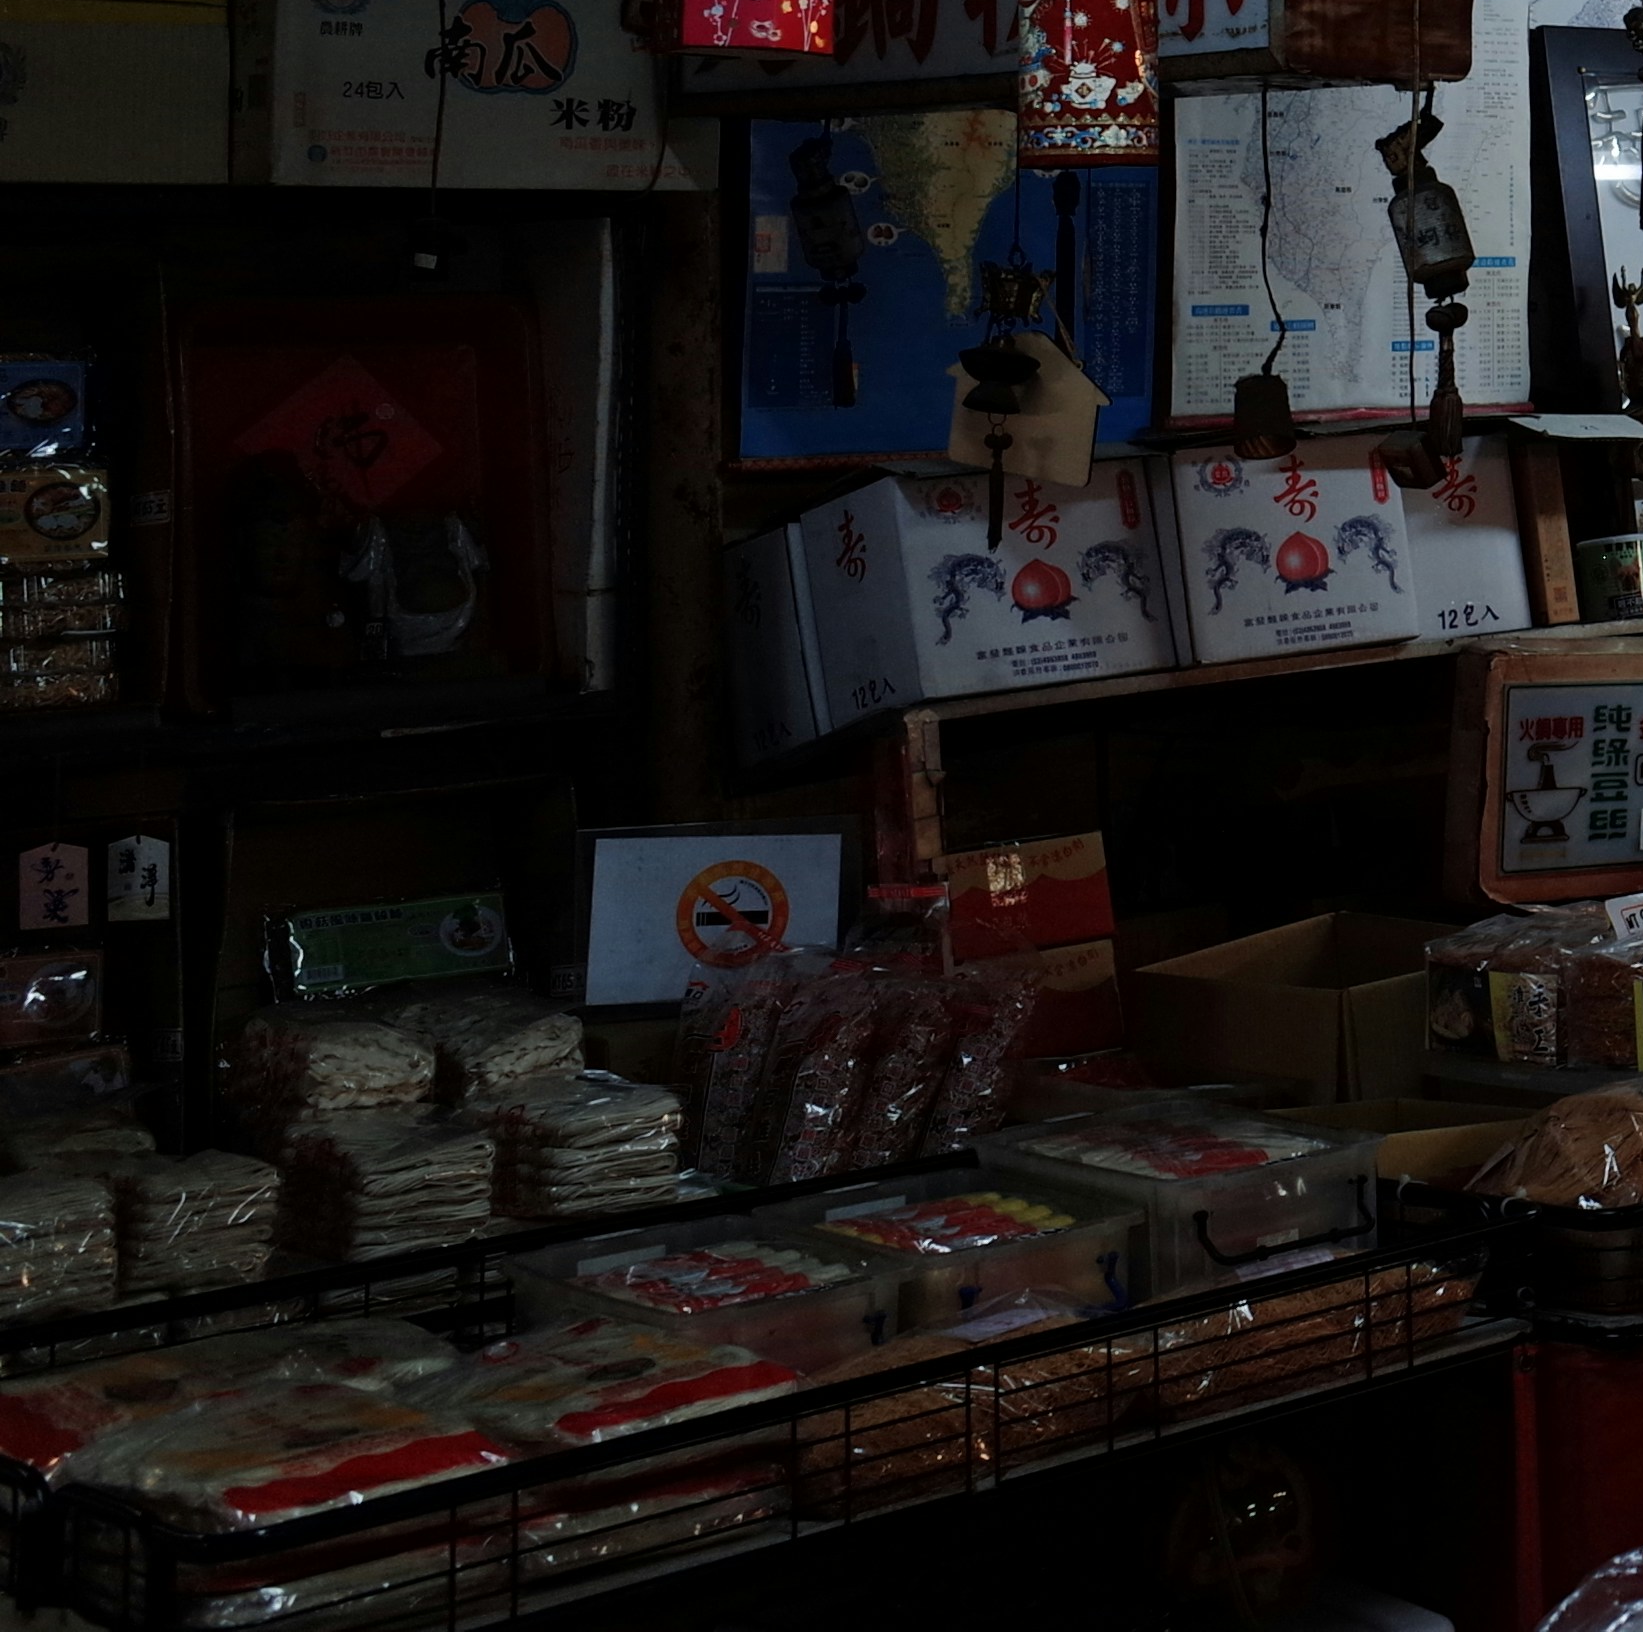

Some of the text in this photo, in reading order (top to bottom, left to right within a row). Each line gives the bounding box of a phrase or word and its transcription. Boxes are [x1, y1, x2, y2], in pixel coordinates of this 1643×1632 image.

[424, 14, 564, 88] 南瓜
[549, 96, 637, 132] 米粉
[1438, 603, 1501, 631] 12包入
[852, 677, 898, 711] 12包入
